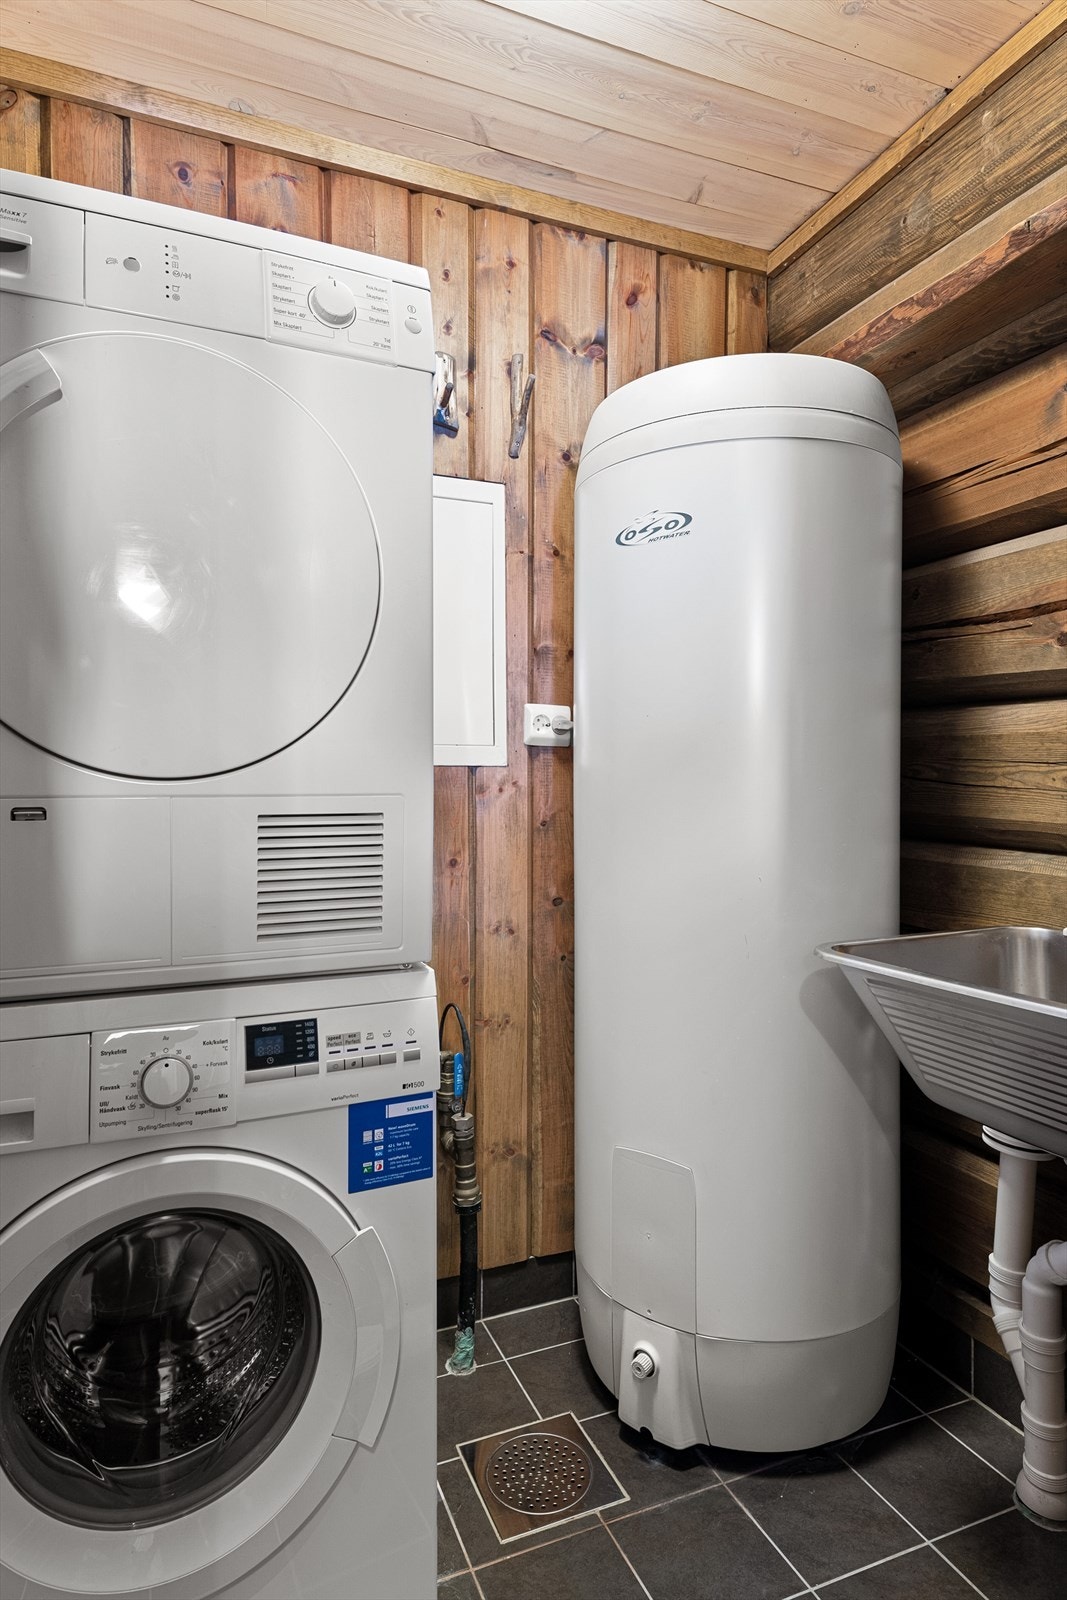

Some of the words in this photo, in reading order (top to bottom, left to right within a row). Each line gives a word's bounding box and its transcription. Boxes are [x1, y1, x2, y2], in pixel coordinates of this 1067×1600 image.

[648, 530, 691, 543] HOTWATER
[331, 1093, 359, 1101] varioPerfect
[406, 1104, 429, 1112] SIEMENS
[99, 1120, 127, 1128] Utpumping
